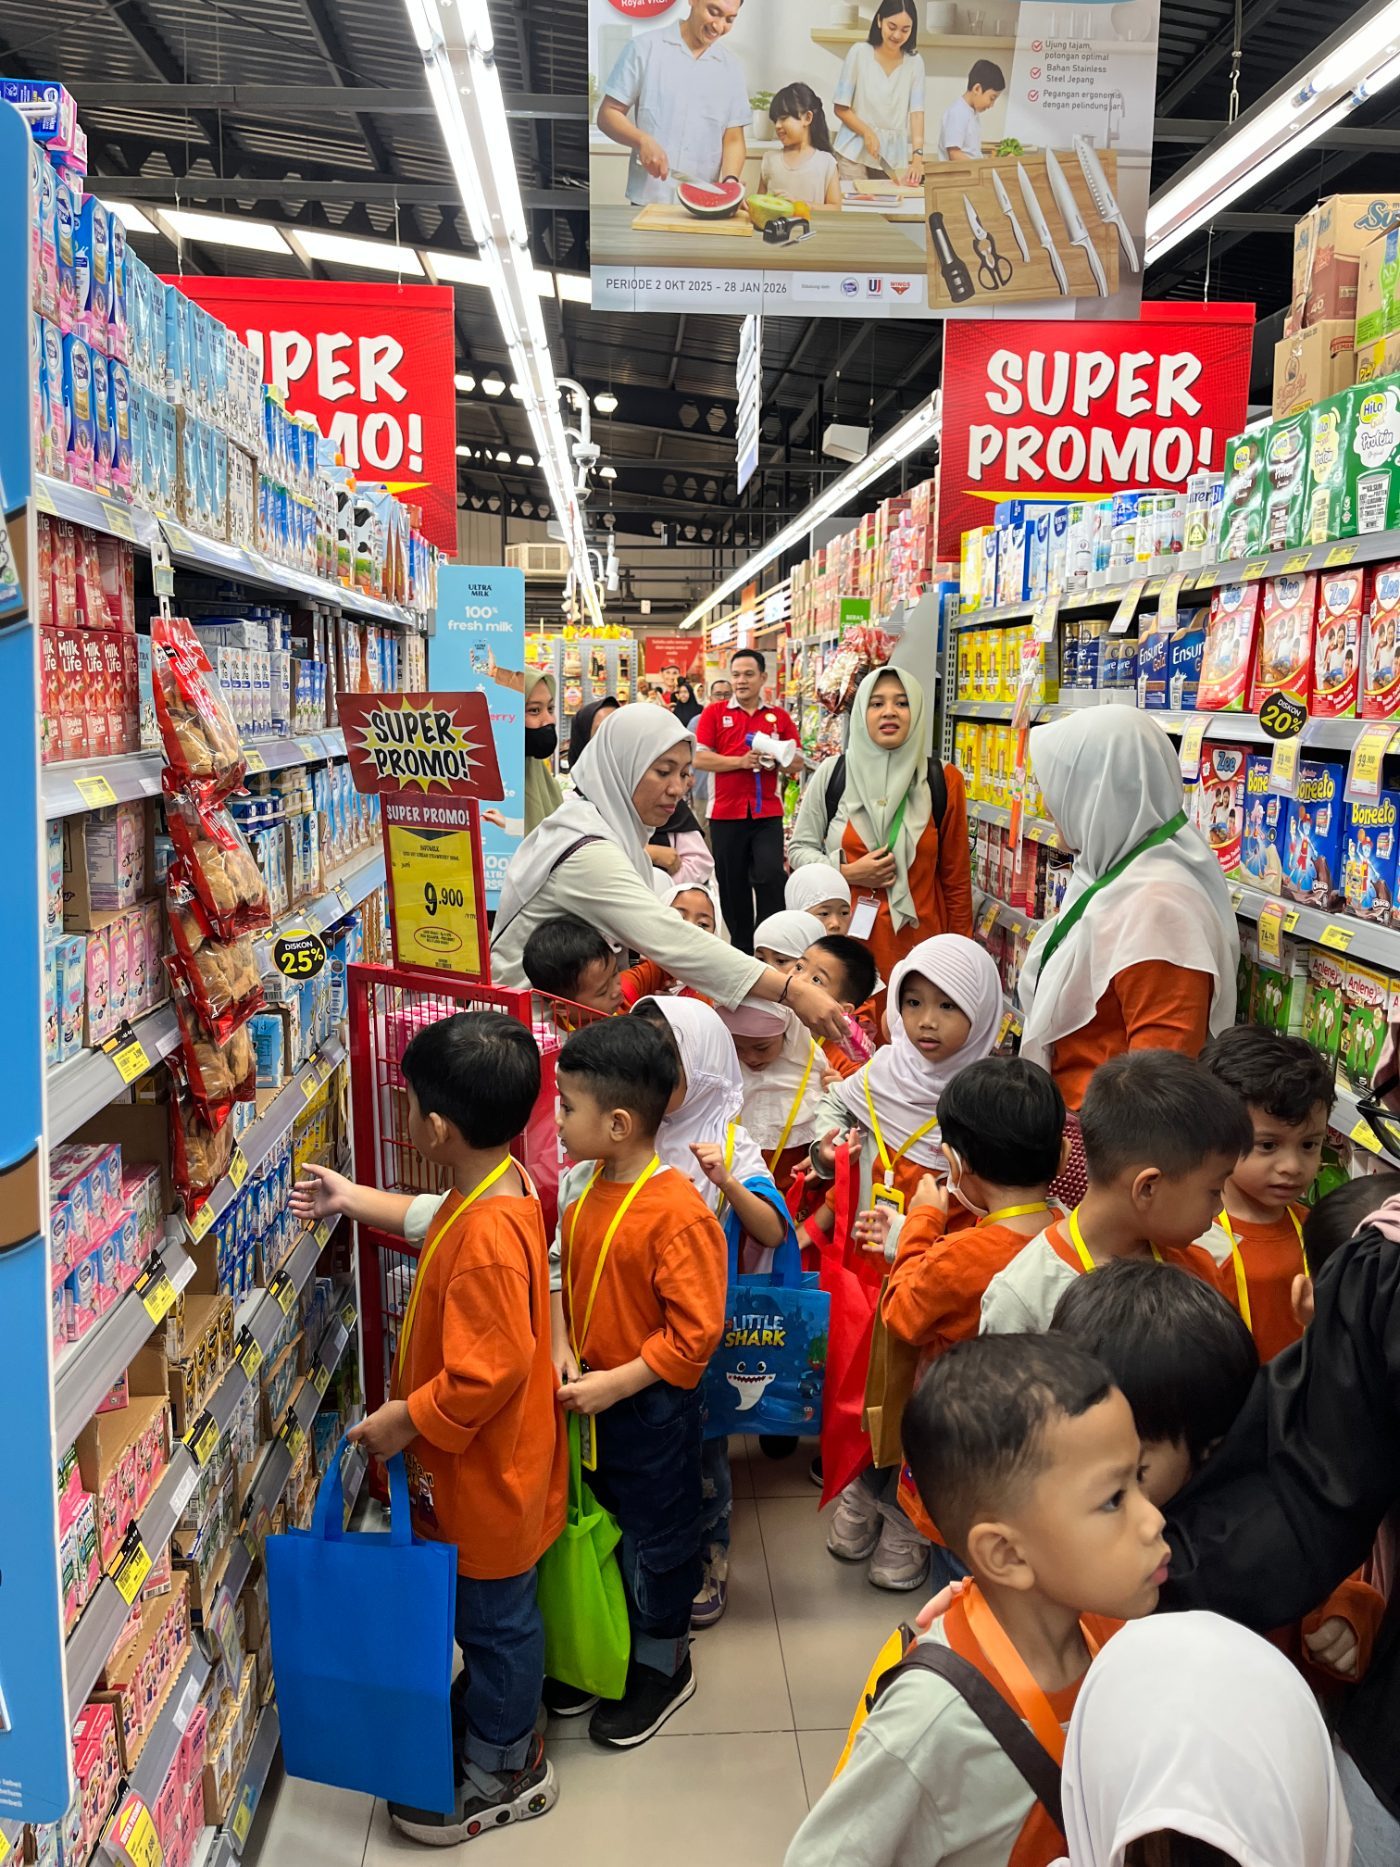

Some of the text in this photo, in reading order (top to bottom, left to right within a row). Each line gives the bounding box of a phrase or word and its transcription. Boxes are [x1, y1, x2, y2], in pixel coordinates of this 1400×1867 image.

[1045, 40, 1092, 50] Ujung tajam,
[1044, 52, 1109, 61] potongan optimal
[1046, 63, 1107, 73] Bahan Stainless
[1046, 74, 1095, 85] Steel Jepang
[1043, 89, 1080, 99] Pegangan
[1042, 101, 1070, 110] dengan
[1071, 102, 1107, 111] pelindung
[606, 278, 652, 290] PERIODE
[655, 279, 661, 290] 2
[664, 280, 686, 291] OKT
[688, 281, 712, 292] 2025
[724, 282, 737, 293] 28
[739, 282, 760, 293] JAN
[763, 282, 787, 294] 2026
[869, 279, 882, 293] UJ
[984, 349, 1203, 417] SUPER
[1363, 401, 1383, 416] HiLo
[967, 424, 1213, 483] PROMO!
[465, 605, 499, 619] 100%
[448, 619, 513, 633] fresh milk
[58, 639, 80, 657] Milk
[83, 641, 101, 658] Milk
[104, 643, 120, 659] Milk
[1139, 641, 1164, 666] Ensure
[1172, 641, 1205, 665] Ensur
[63, 655, 83, 673] Life
[87, 657, 104, 673] Life
[106, 658, 122, 673] Life
[1152, 652, 1167, 672] Gold
[1277, 698, 1302, 718] DISKON
[370, 710, 457, 746] SUPER
[1260, 705, 1303, 733] 20%
[373, 746, 469, 780] PROMO!
[1217, 751, 1237, 773] Zee
[1247, 769, 1269, 795] Bone
[386, 804, 470, 826] SUPER PROMO!
[1351, 799, 1396, 826] Boneeto
[424, 881, 464, 916] 9.900
[284, 939, 313, 951] DISKON
[280, 946, 324, 974] 25%
[1312, 959, 1337, 982] Anlene
[1348, 976, 1375, 999] Anlene
[732, 1313, 785, 1332] LITTLE
[724, 1329, 788, 1348] SHARK
